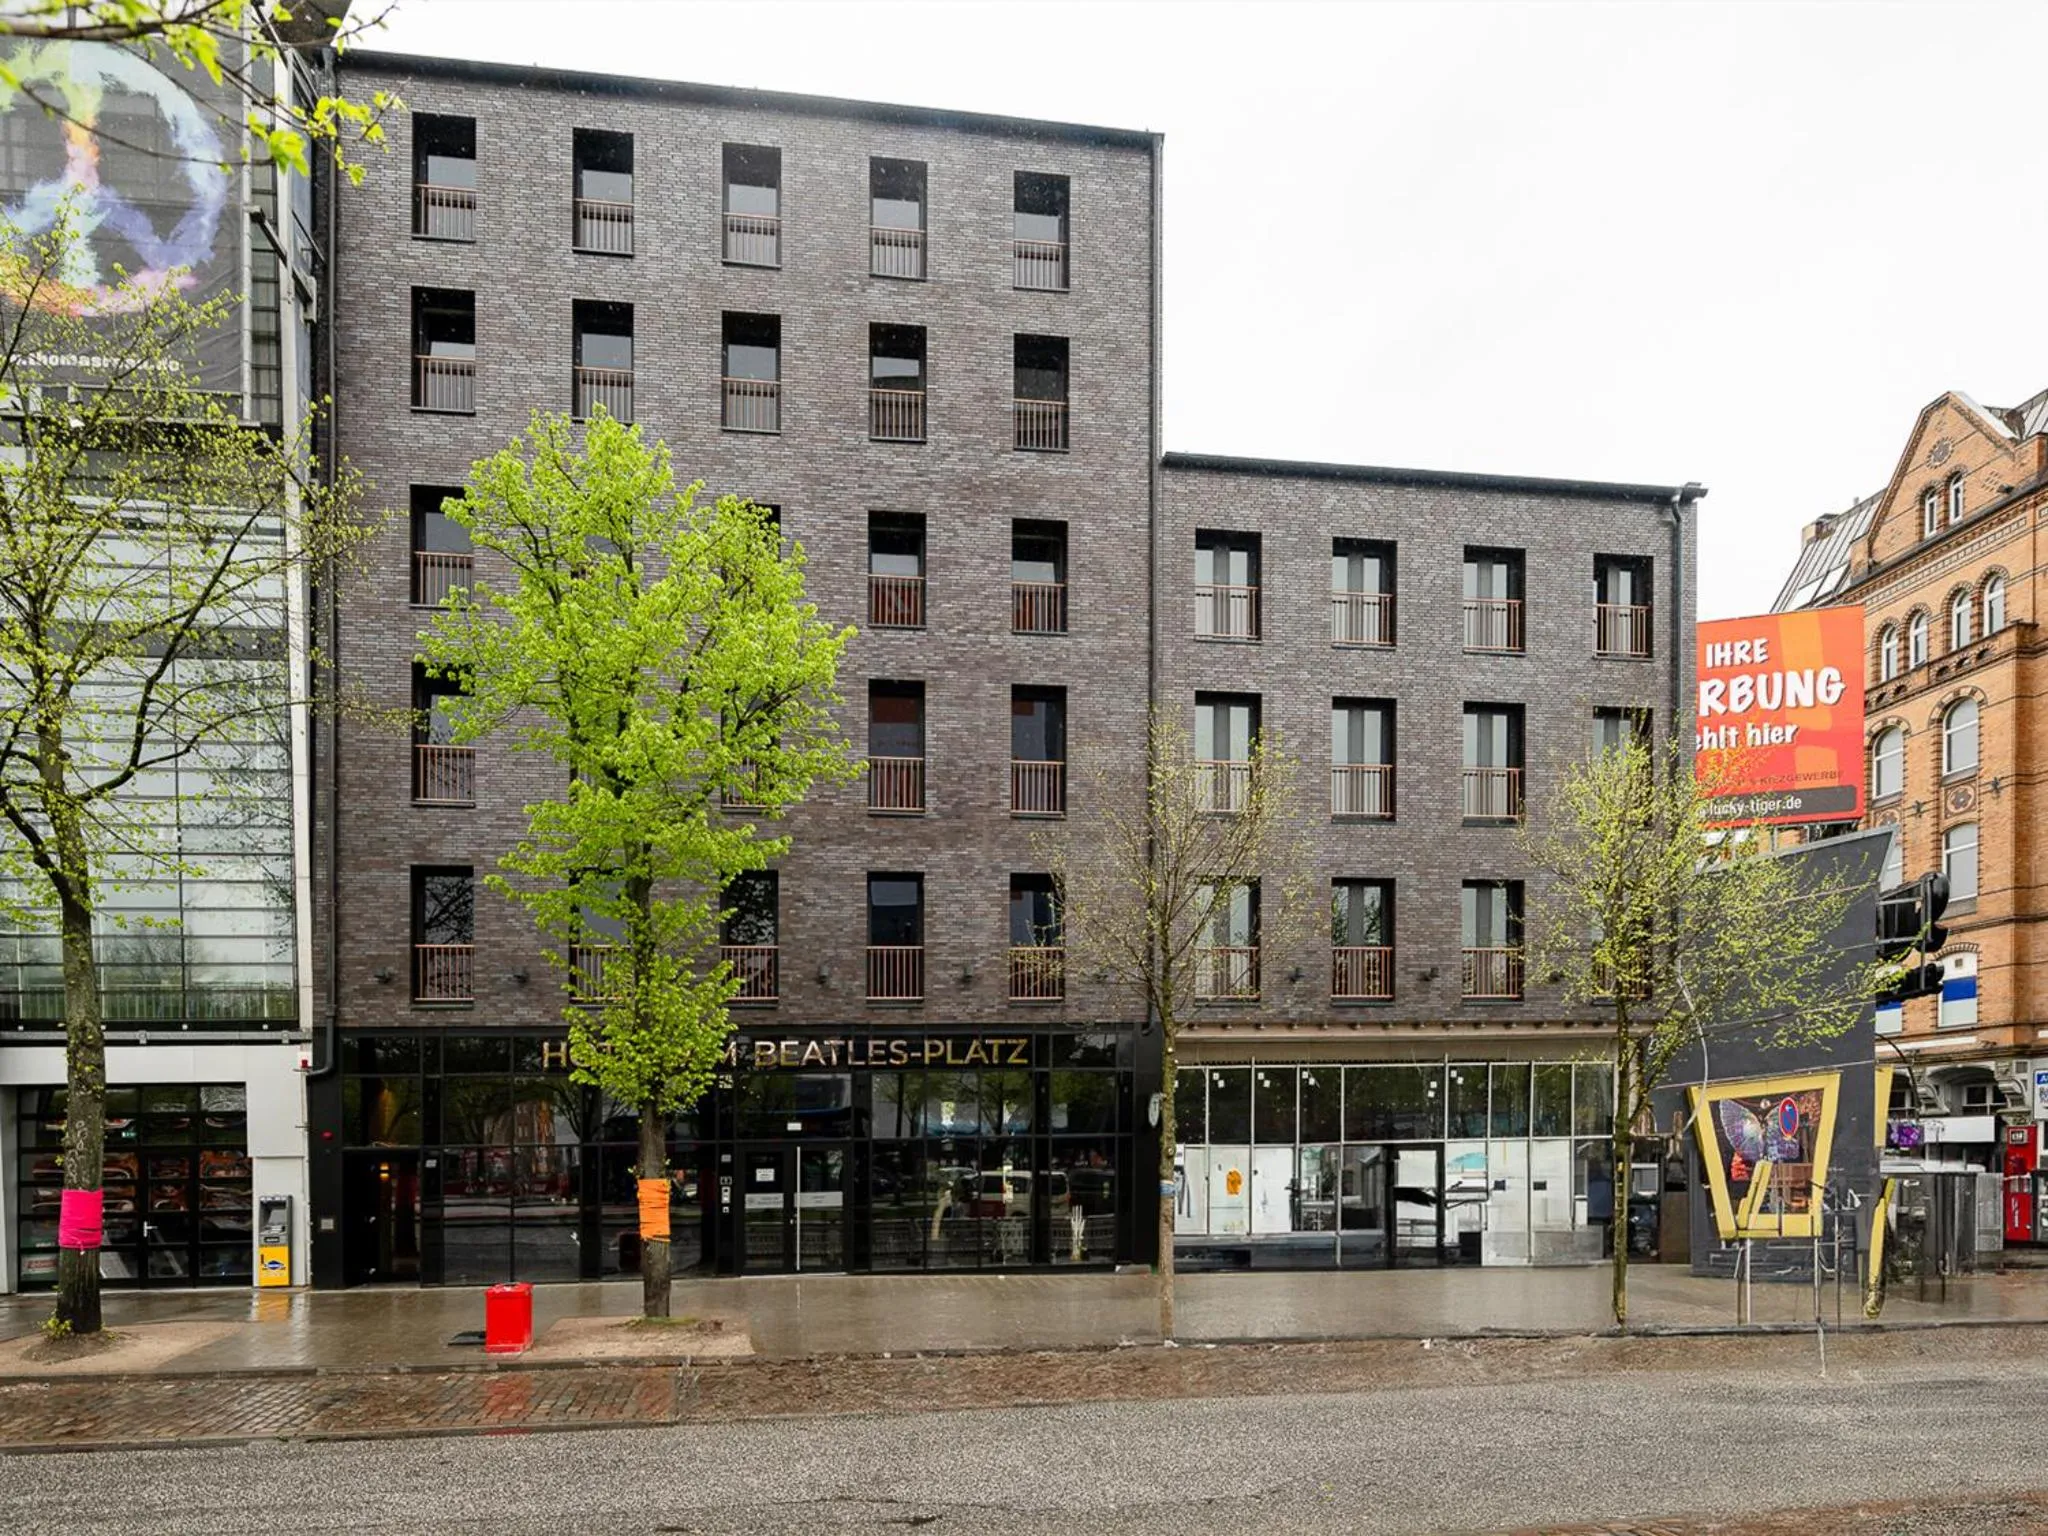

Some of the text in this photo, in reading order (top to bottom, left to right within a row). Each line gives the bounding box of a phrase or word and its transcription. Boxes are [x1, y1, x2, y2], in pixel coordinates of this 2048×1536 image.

[1705, 638, 1769, 669] IHRE
[1698, 666, 1847, 718] RBUNG
[1746, 721, 1799, 747] hier
[753, 1039, 1029, 1068] BEATLES-PLATZ
